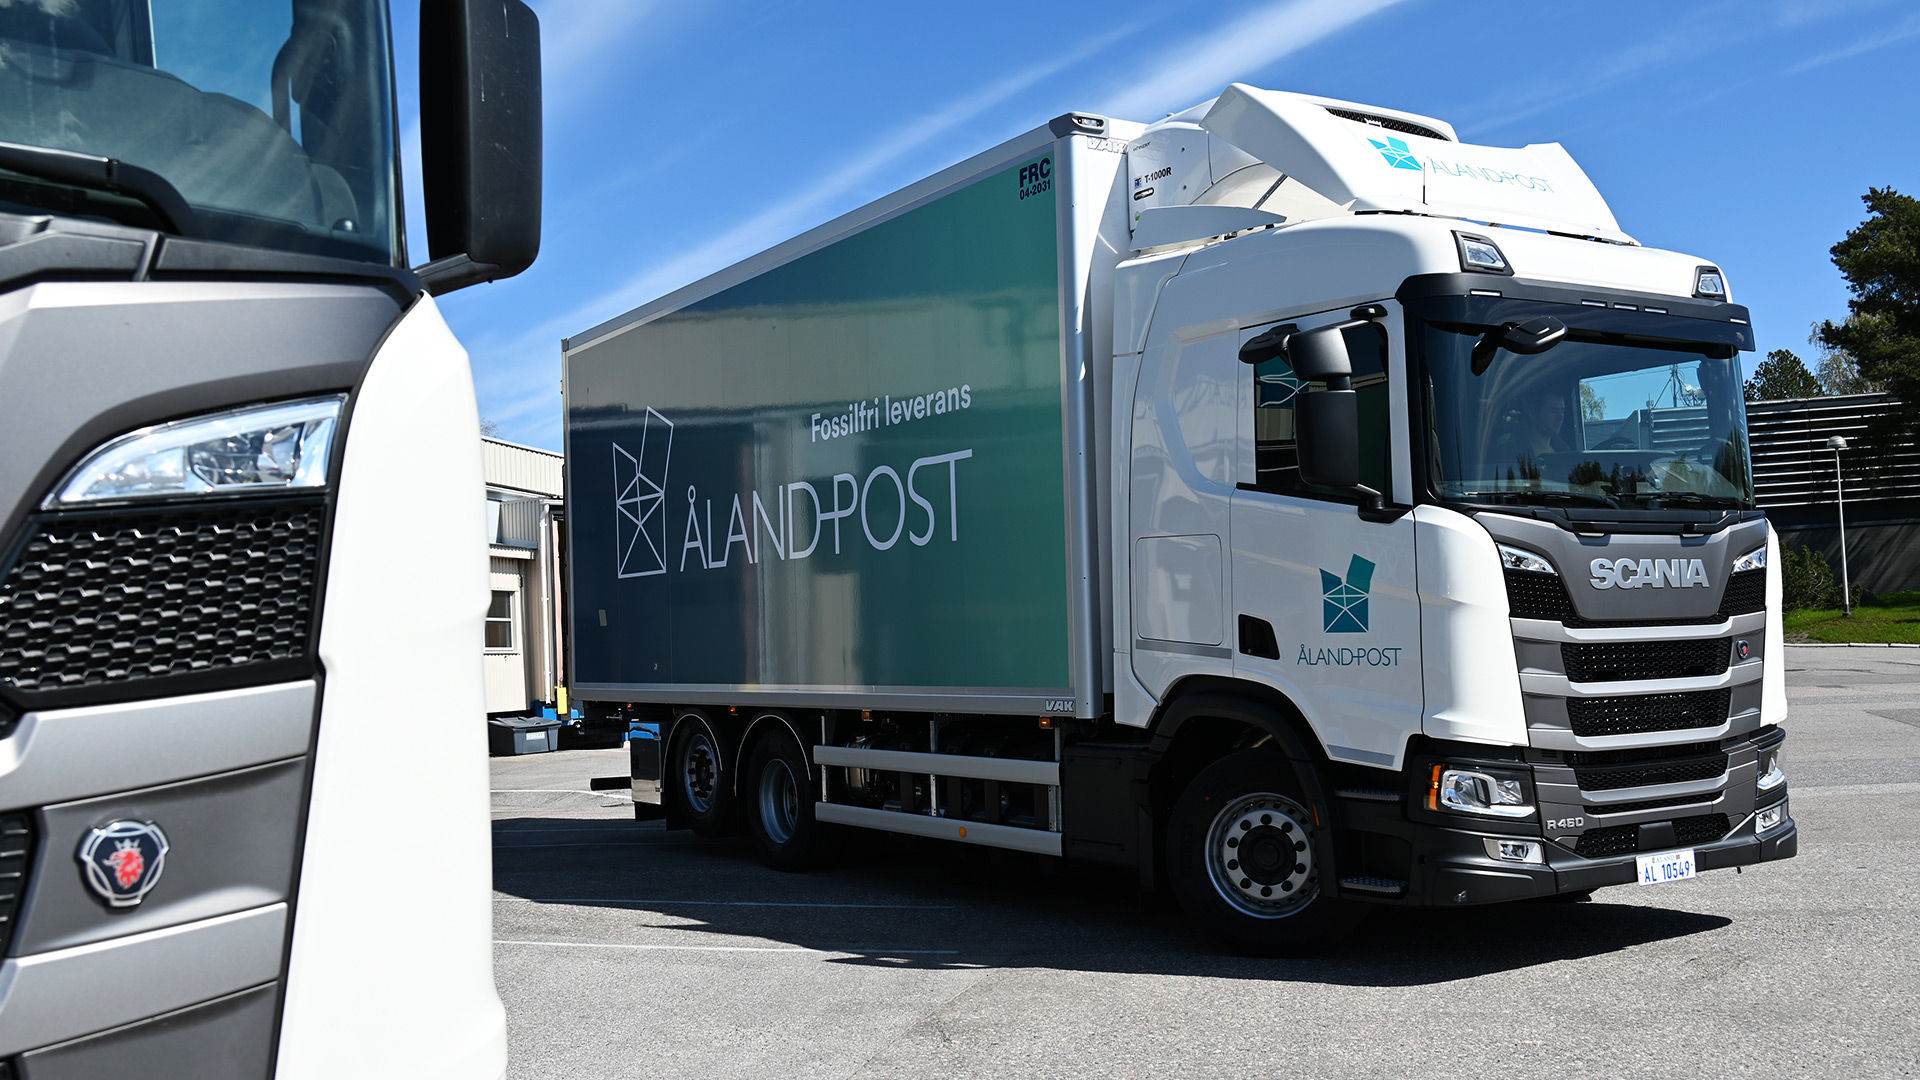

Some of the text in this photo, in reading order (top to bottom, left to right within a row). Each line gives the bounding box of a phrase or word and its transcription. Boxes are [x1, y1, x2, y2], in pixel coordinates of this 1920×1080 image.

[1019, 157, 1051, 188] FRC
[1145, 167, 1172, 183] T-1000R
[1020, 179, 1051, 200] 04-2031
[811, 384, 972, 442] Fossilfri leverans
[1589, 557, 1710, 590] SCANIA
[1045, 699, 1075, 712] VAK
[1661, 860, 1690, 880] 10549
